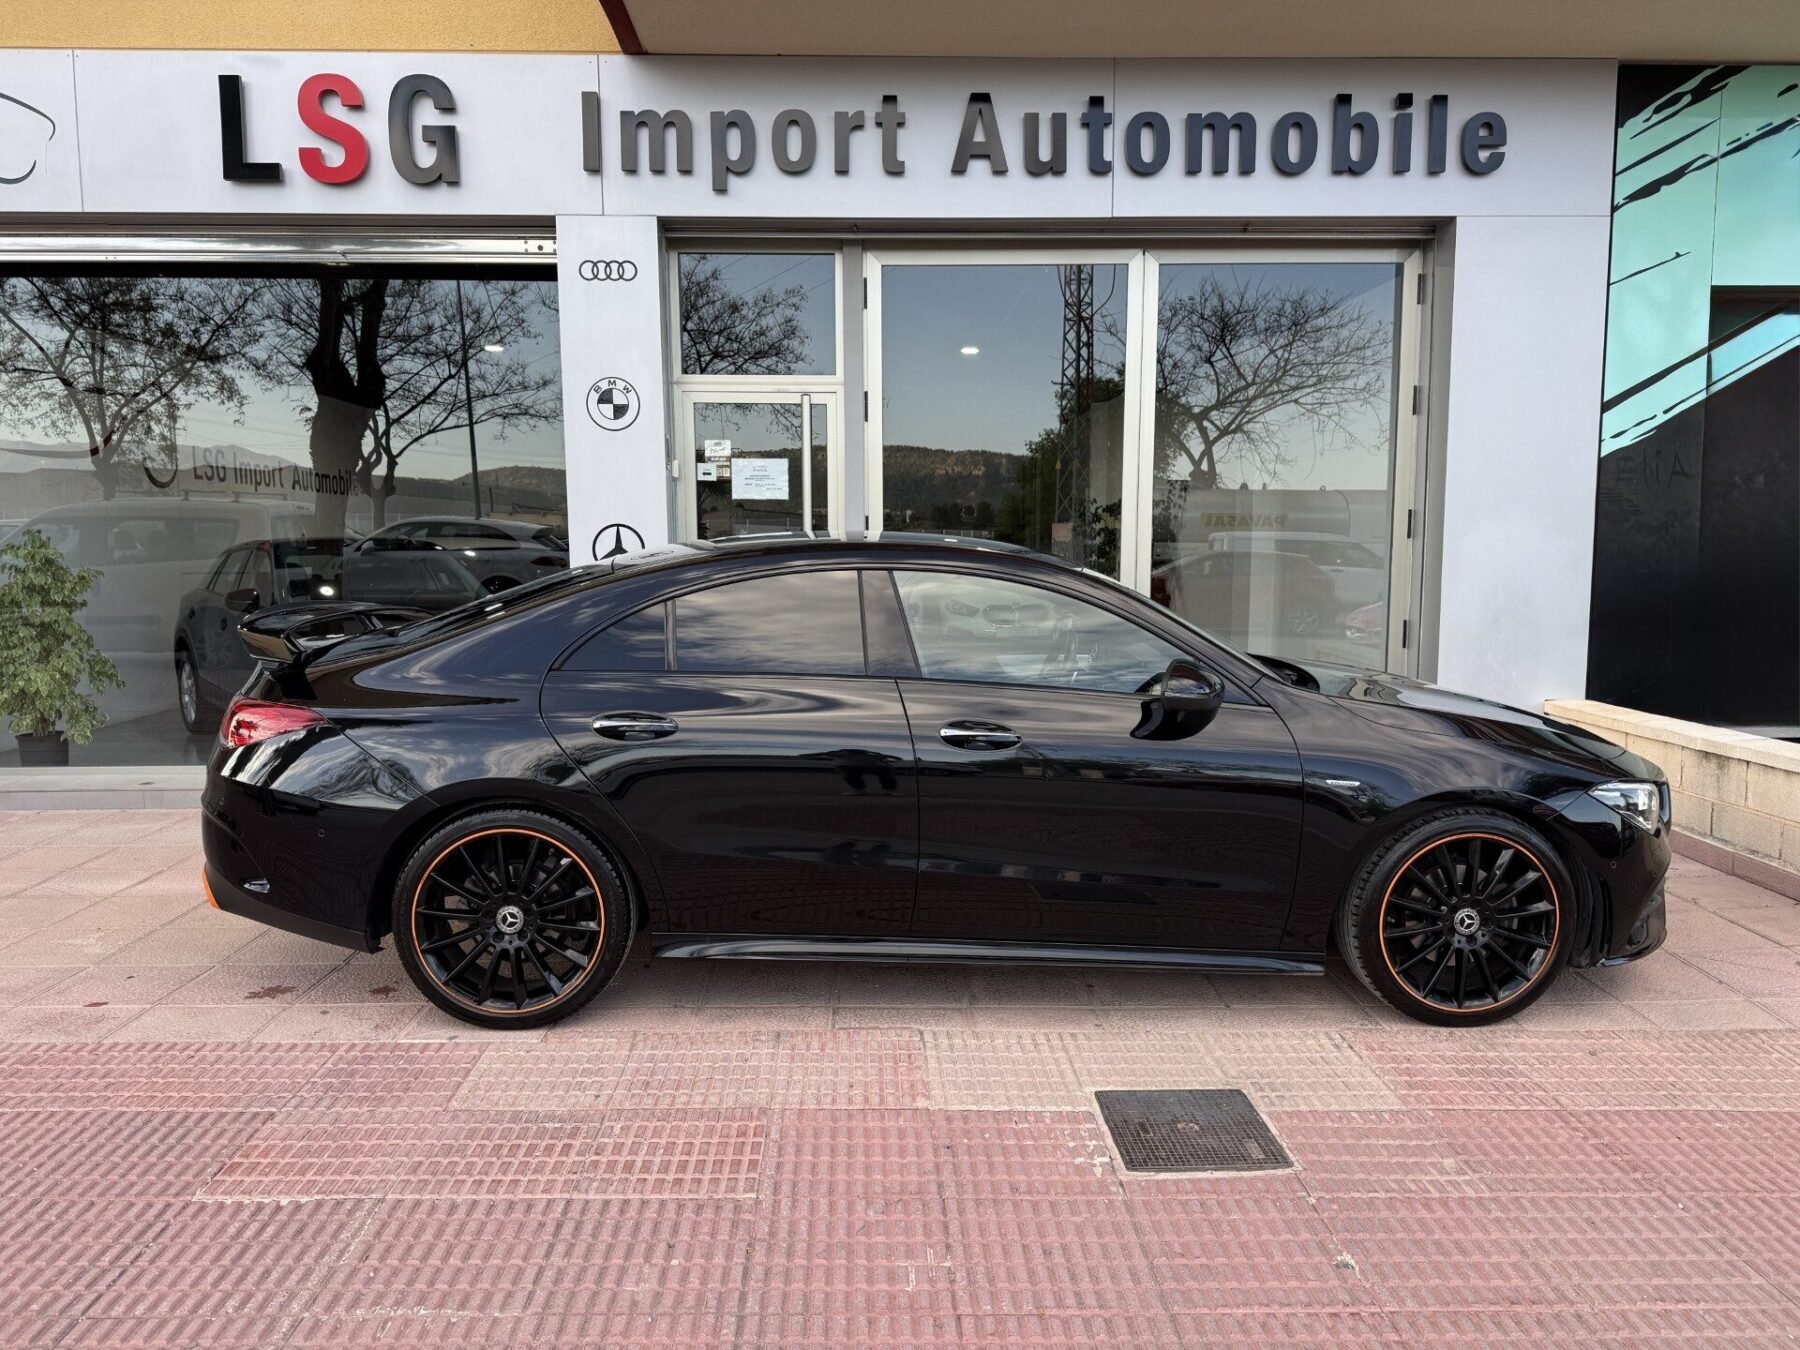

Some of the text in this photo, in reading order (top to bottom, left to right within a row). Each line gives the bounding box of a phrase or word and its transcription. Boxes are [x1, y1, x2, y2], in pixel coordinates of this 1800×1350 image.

[218, 73, 1507, 192] LSG Import Automobile
[593, 380, 632, 394] BMW
[191, 446, 227, 482] LSG
[232, 450, 285, 492] Import
